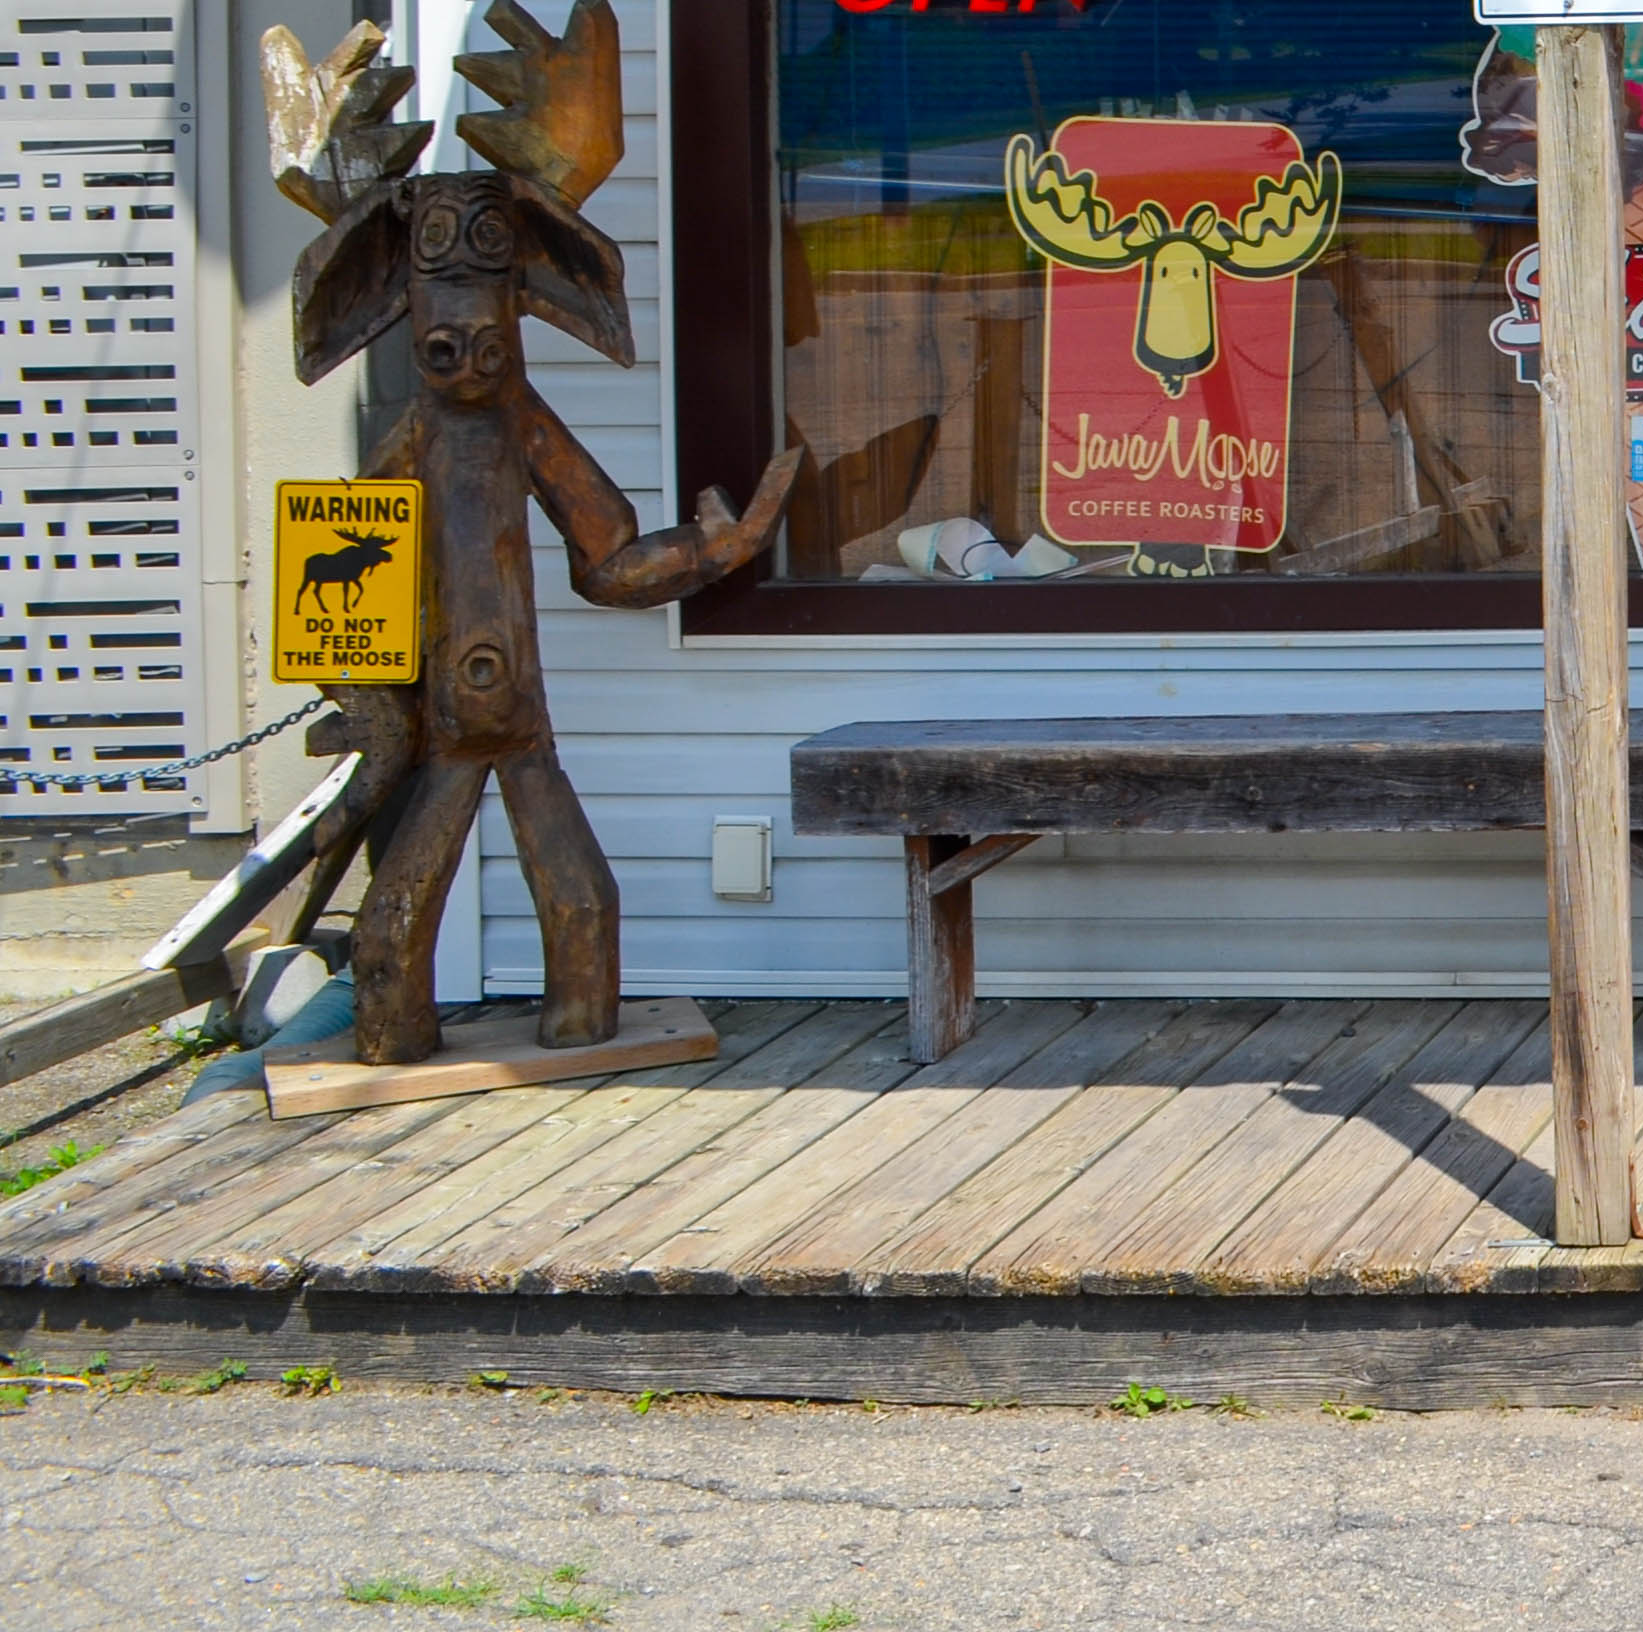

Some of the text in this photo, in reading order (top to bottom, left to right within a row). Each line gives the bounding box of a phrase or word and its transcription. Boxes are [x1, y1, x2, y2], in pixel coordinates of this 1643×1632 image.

[287, 496, 410, 523] WARNING
[1068, 500, 1266, 525] COFFEE ROASTERS
[306, 619, 387, 633] DO NOT
[320, 635, 371, 650] FEED
[283, 651, 407, 666] THE MOOSE
